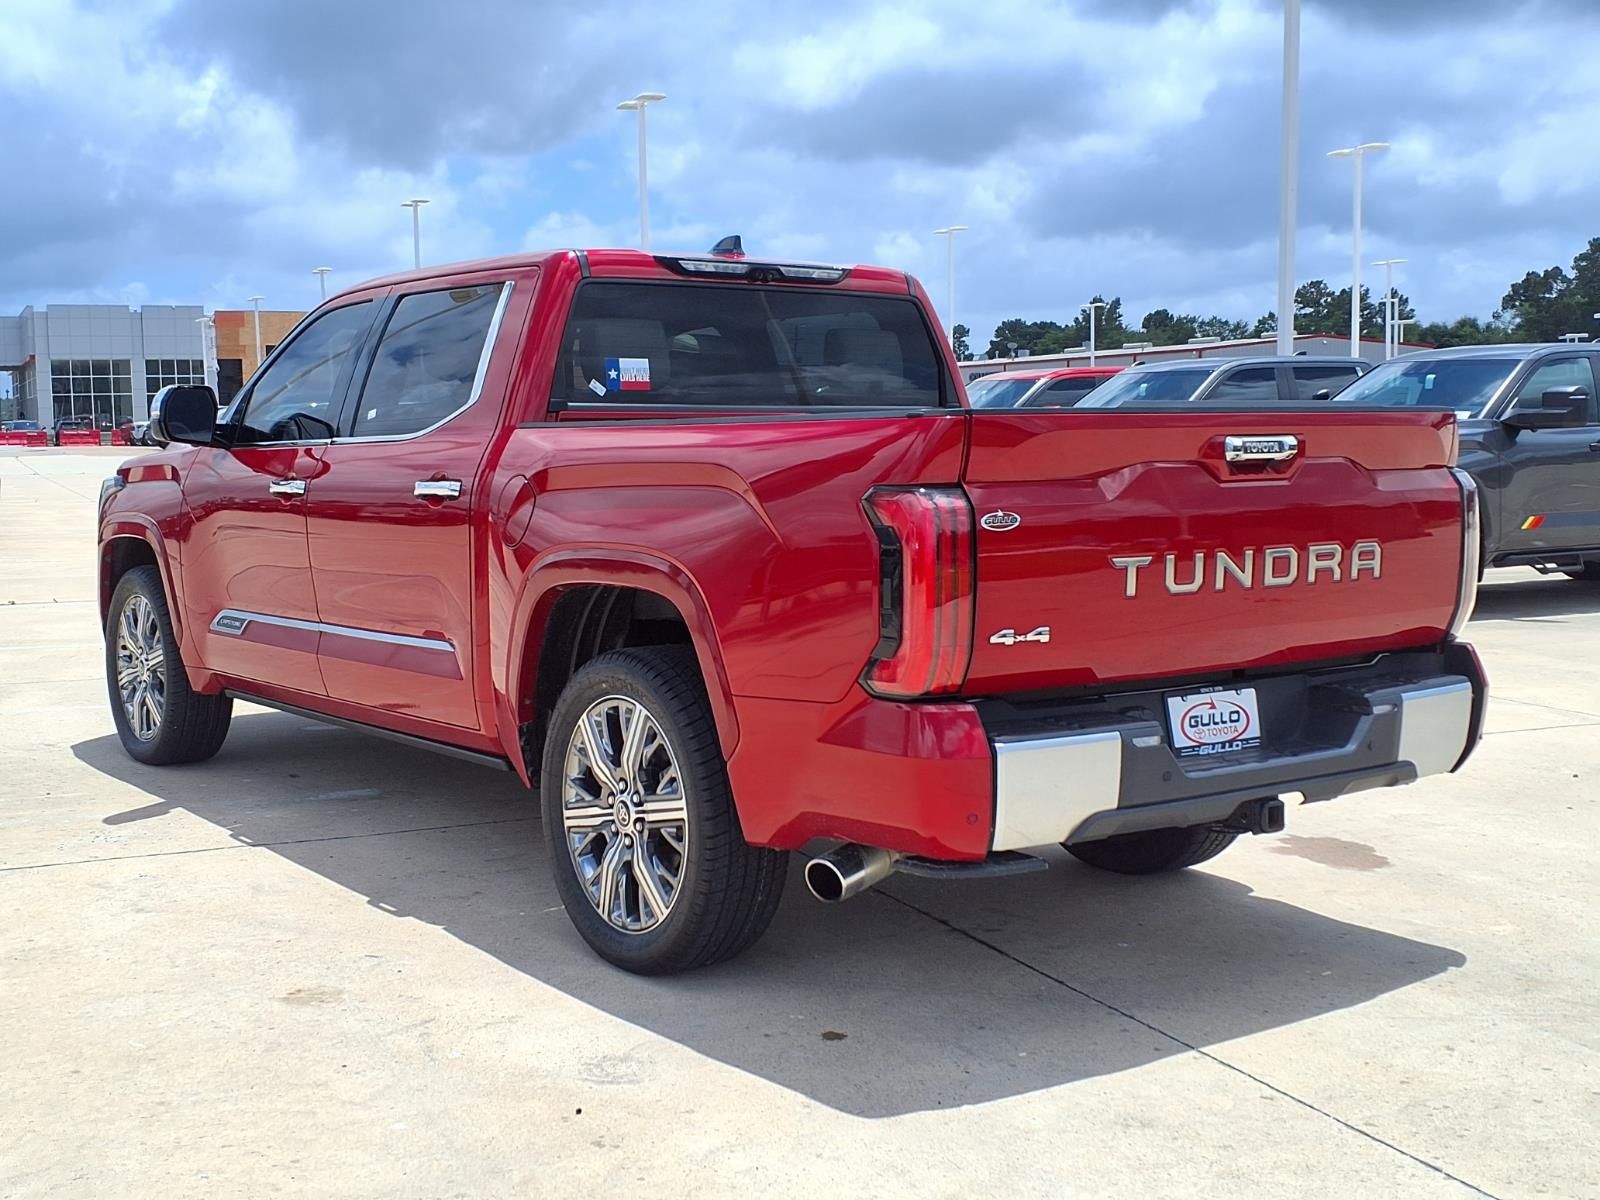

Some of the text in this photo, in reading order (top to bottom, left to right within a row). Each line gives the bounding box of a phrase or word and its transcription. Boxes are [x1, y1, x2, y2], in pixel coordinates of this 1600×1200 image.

[1245, 442, 1280, 453] TOYOTA
[984, 516, 1018, 525] GULLO
[1109, 540, 1382, 598] TUNDRA
[989, 626, 1050, 645] 4x4
[1188, 710, 1241, 729] GULLO
[1207, 725, 1239, 737] TOYOTA
[1199, 741, 1242, 755] GULLO
